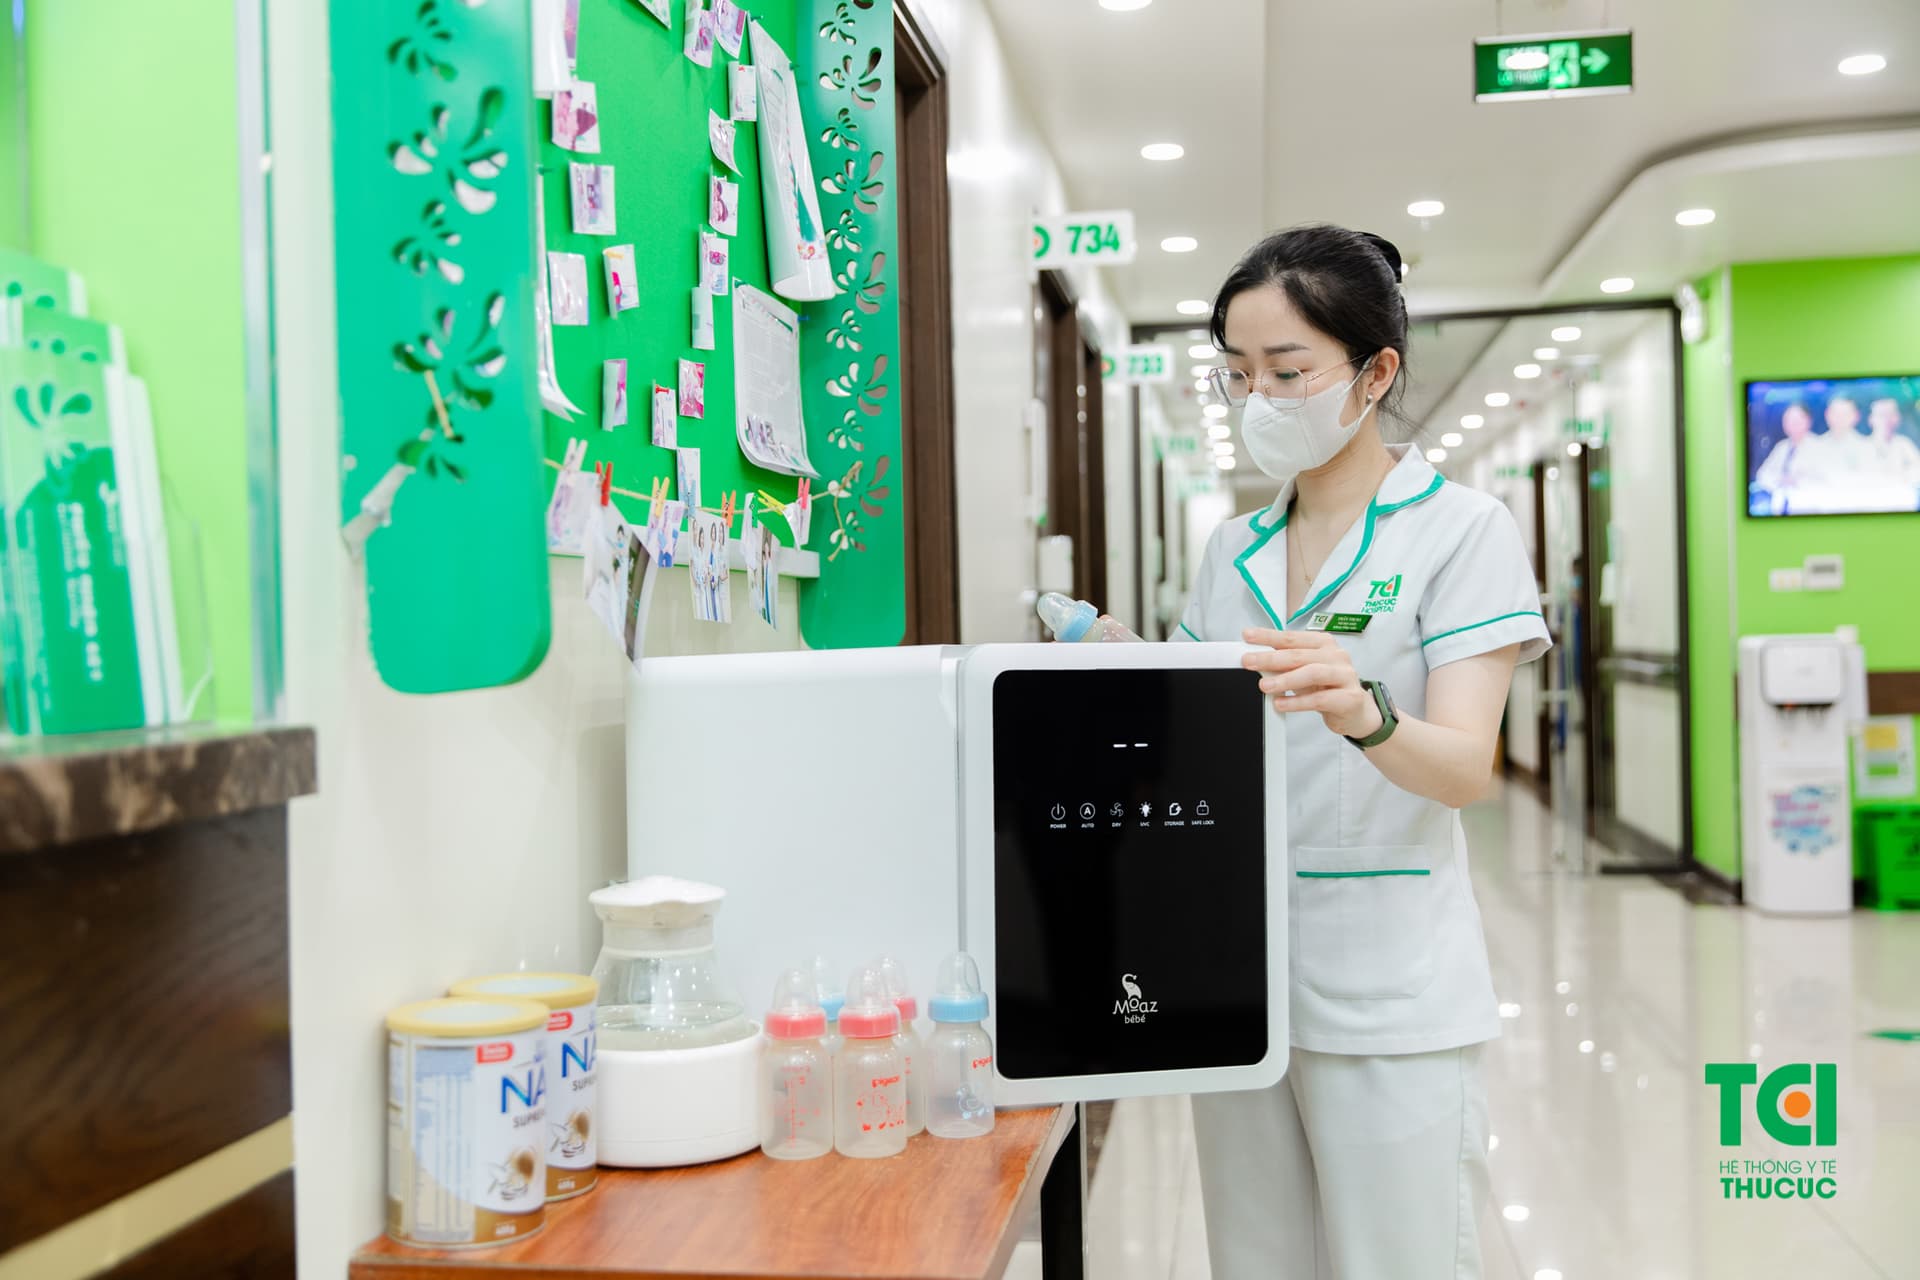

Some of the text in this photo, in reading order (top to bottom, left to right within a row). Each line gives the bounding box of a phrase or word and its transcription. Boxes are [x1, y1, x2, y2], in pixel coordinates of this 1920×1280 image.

[1066, 224, 1119, 254] 734
[1367, 574, 1402, 599] TCI
[1124, 1014, 1147, 1024] bébé
